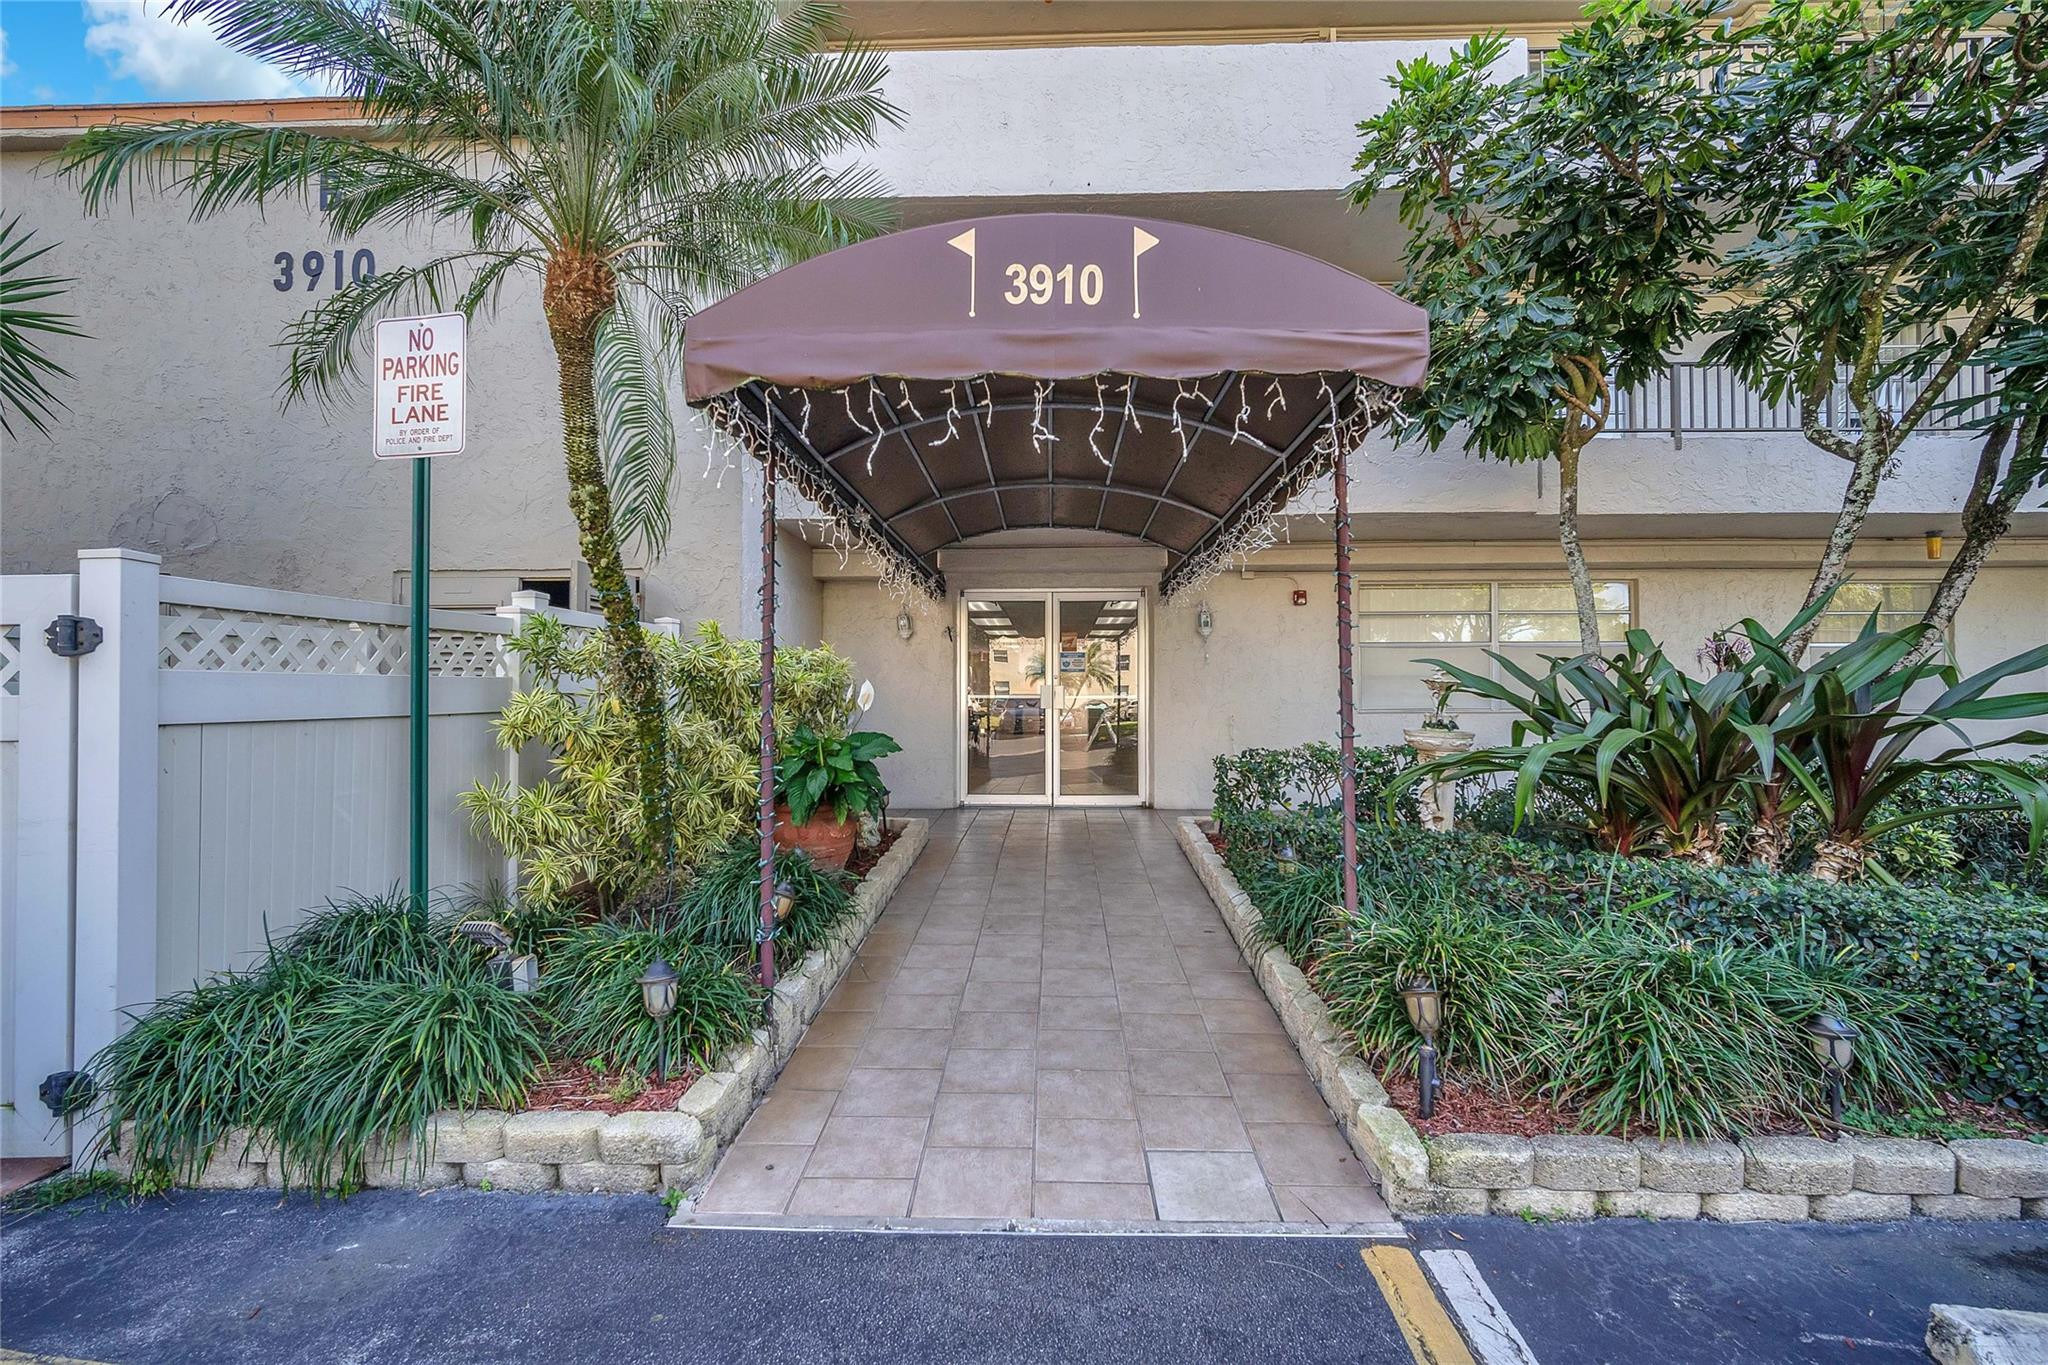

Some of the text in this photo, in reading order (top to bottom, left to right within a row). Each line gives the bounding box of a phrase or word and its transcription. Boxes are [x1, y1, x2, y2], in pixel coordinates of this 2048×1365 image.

[273, 248, 376, 292] 3910
[1004, 263, 1104, 305] 3910
[409, 327, 434, 352] NO
[383, 352, 459, 381] PARKING
[398, 383, 443, 403] FIRE
[392, 404, 449, 424] LANE
[385, 437, 406, 445] POLICE
[399, 427, 440, 437] BY ORDER OF
